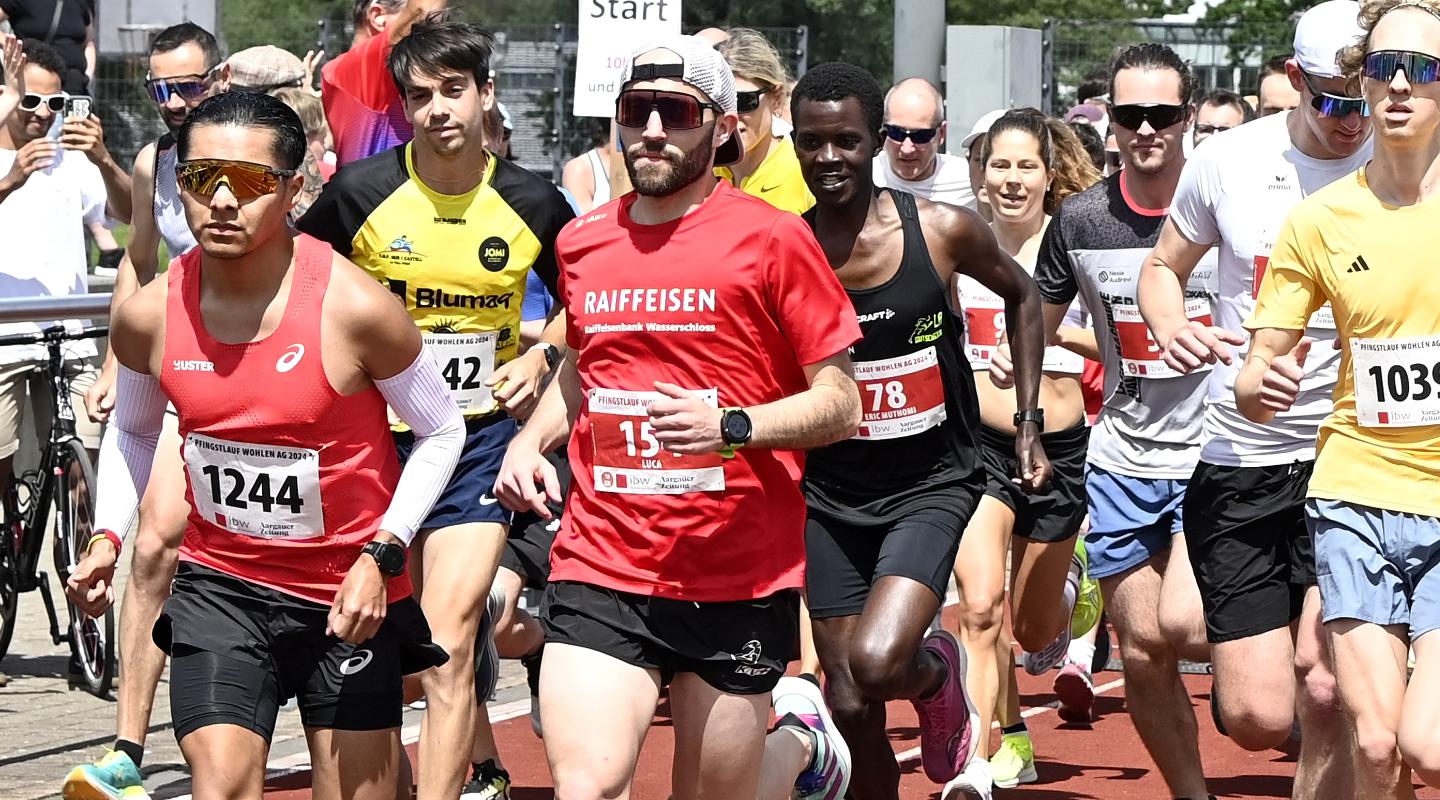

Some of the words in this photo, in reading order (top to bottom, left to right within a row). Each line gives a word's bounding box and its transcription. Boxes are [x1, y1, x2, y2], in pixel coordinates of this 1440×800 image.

[590, 0, 668, 21] Start
[606, 57, 626, 69] 10
[588, 82, 614, 92] und
[484, 248, 505, 257] JOMI
[416, 287, 514, 309] Blumaq
[584, 288, 716, 314] RAIFFEISEN
[646, 322, 716, 332] Wasserschloss
[466, 337, 474, 345] AG
[475, 336, 489, 344] 2024
[1361, 343, 1399, 352] PFINGSTLAUF
[1401, 340, 1430, 350] WOHLEN
[1432, 339, 1440, 347] AG
[875, 362, 903, 373] WOHLEN
[914, 356, 928, 364] 2024
[598, 396, 639, 407] PFINGSTLAUF
[865, 380, 907, 412] 78
[864, 411, 881, 421] ERIC
[881, 406, 917, 420] MUTHOMI
[1391, 411, 1411, 420] ibw
[872, 425, 890, 433] ibw
[619, 420, 683, 458] 15
[194, 439, 241, 455] PFINGSTLAUF
[242, 448, 275, 458] WOHLEN
[276, 450, 287, 459] AG
[288, 451, 307, 460] 2024
[641, 460, 662, 469] LUCA
[630, 476, 651, 485] ibw
[202, 464, 304, 514] 1244
[229, 515, 250, 529] ibw
